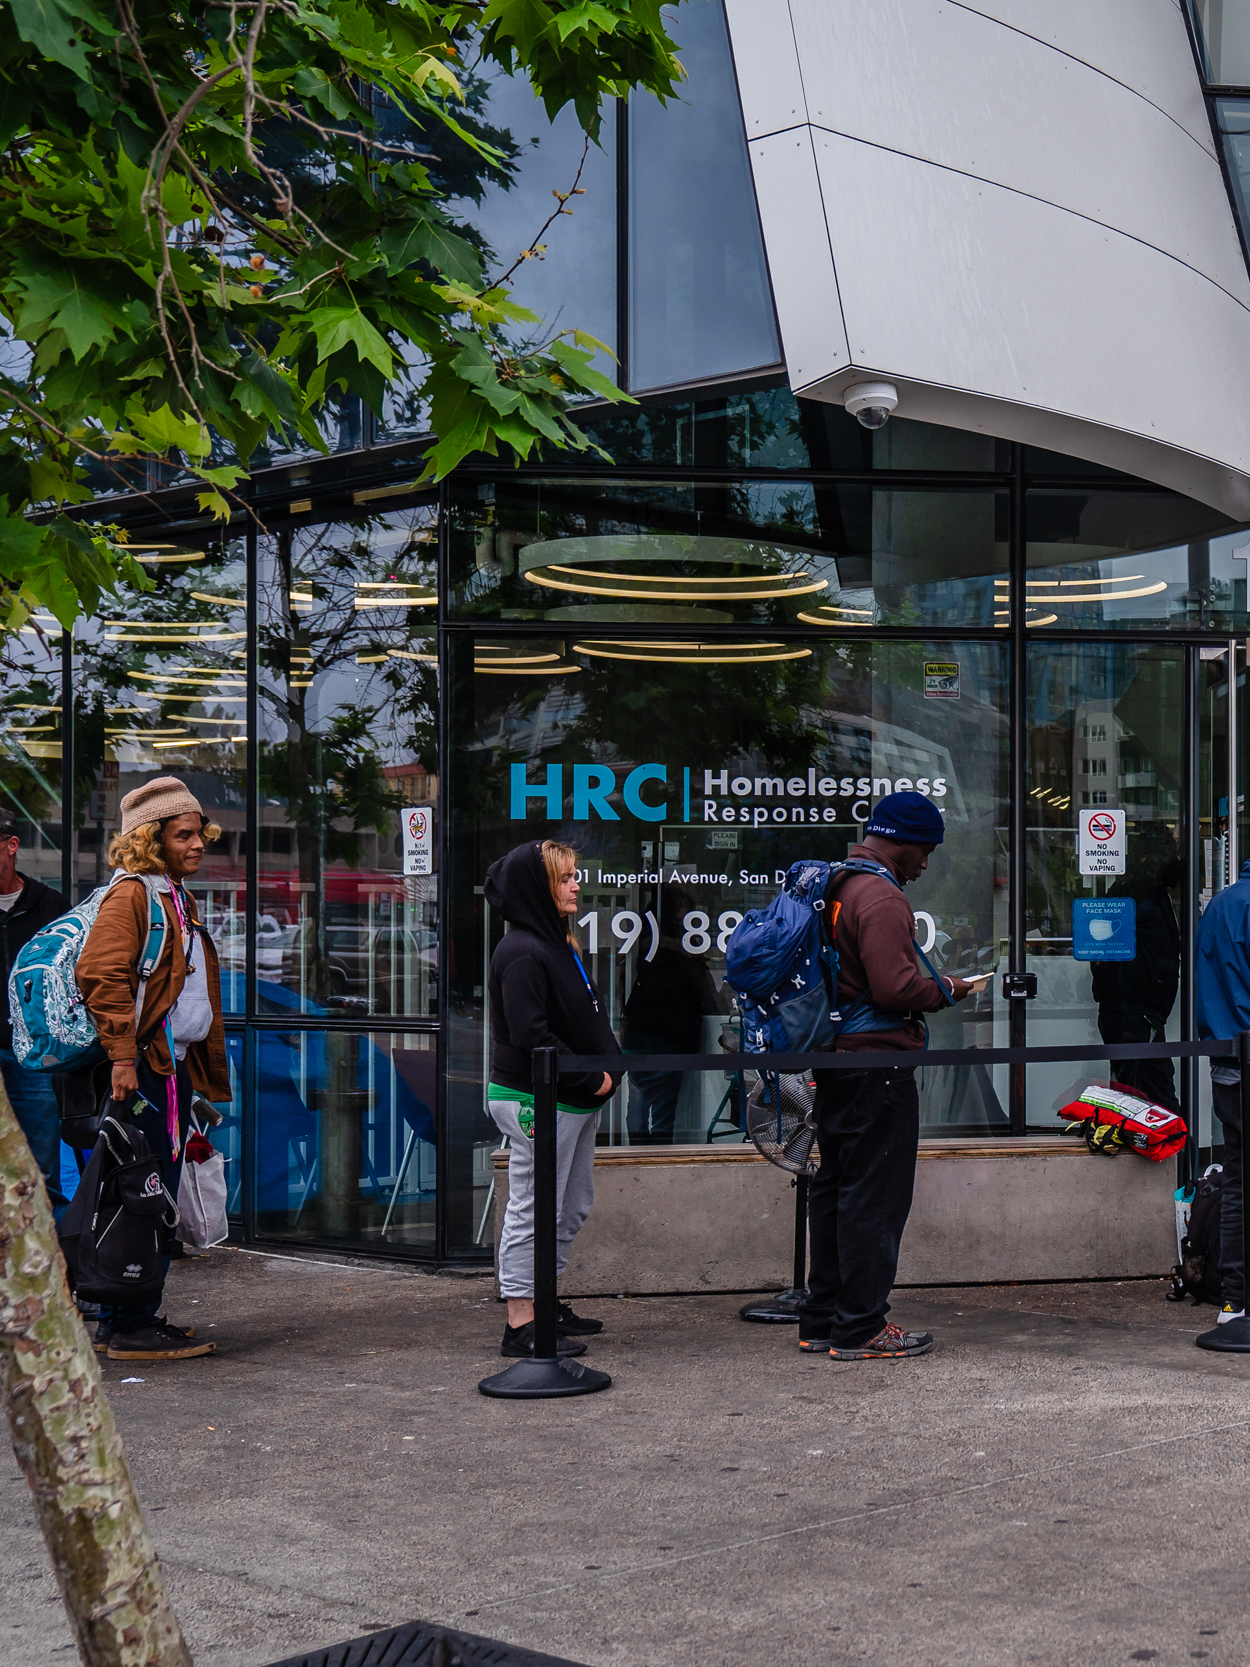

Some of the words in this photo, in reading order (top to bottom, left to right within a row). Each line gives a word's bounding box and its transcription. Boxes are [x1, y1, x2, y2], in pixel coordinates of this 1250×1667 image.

[510, 763, 668, 823] HRC
[704, 767, 947, 797] Homelessness
[704, 800, 837, 829] Response
[872, 825, 896, 834] Diego
[598, 868, 663, 887] Imperial
[668, 869, 733, 887] Avenue,
[739, 870, 769, 885] San
[577, 910, 660, 963] 19)
